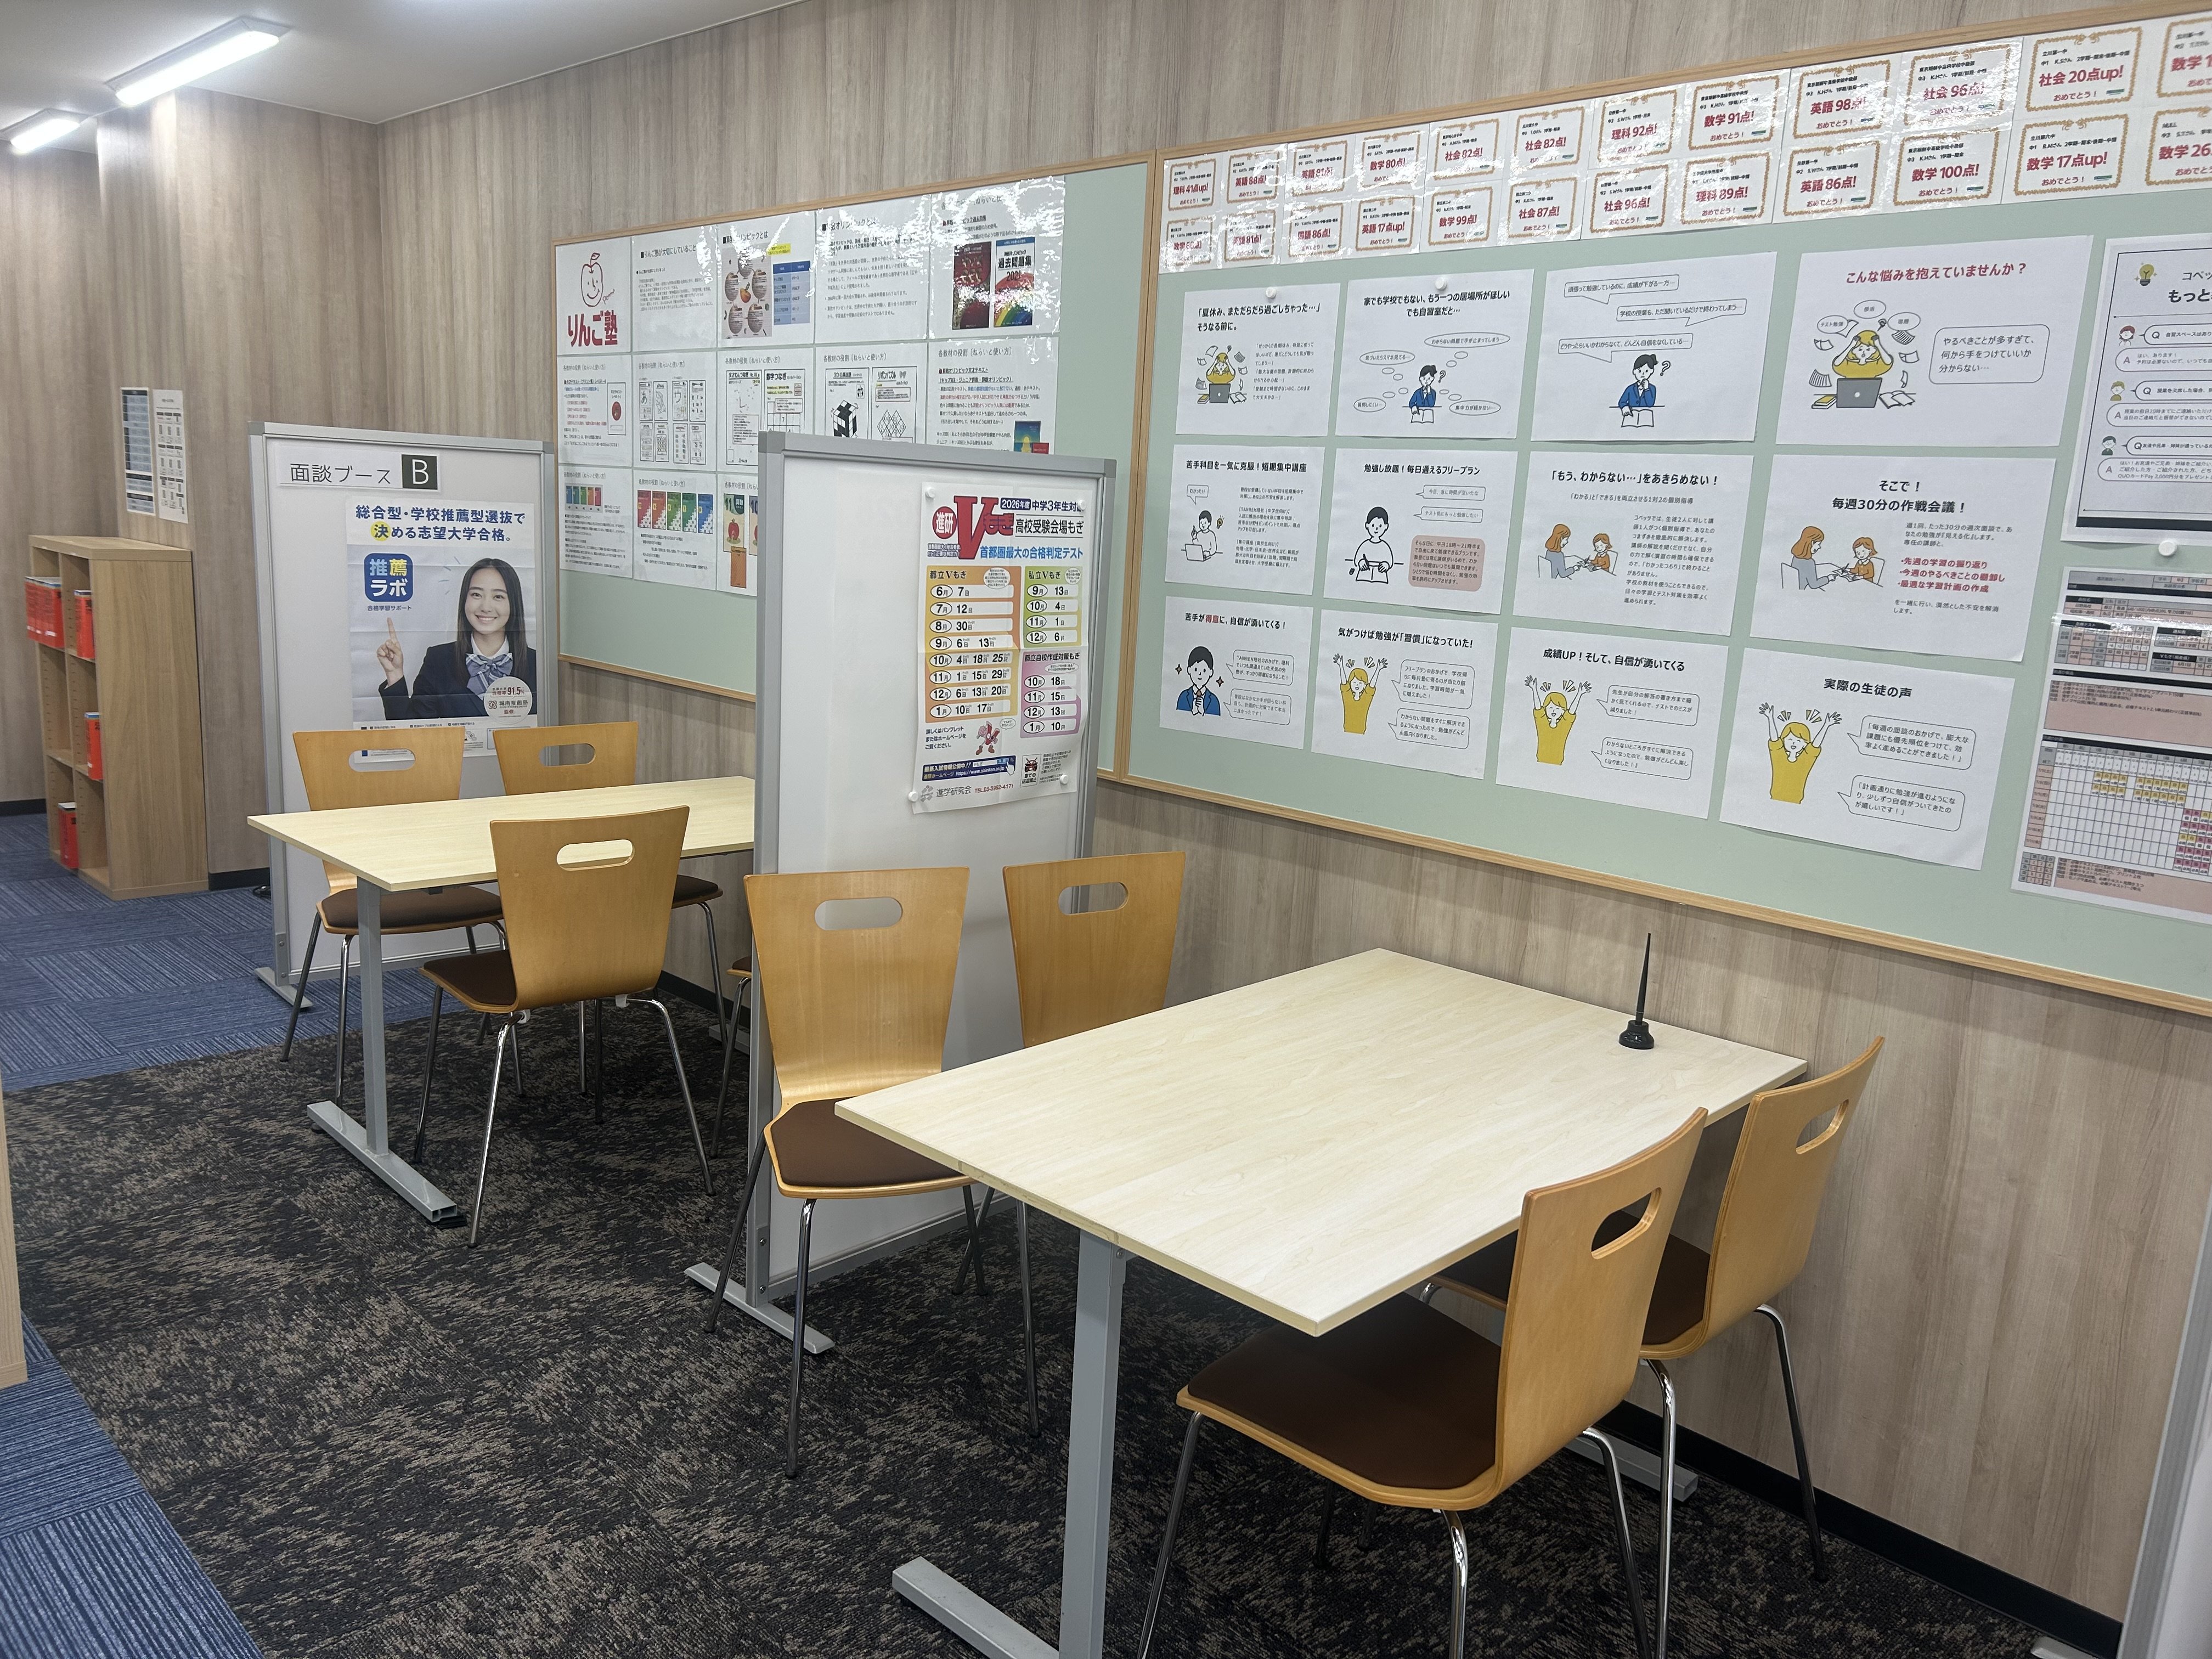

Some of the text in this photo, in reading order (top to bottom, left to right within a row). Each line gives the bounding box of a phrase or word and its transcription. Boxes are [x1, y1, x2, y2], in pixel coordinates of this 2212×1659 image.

[2039, 65, 2123, 87] 社会 20点up!
[1704, 114, 1726, 128] 数学
[1525, 137, 1566, 151] 社会 82点!
[2027, 152, 2107, 172] 数学 17点up!
[1912, 164, 1979, 182] 数学 100点!
[1801, 177, 1856, 193] 英語 86点!
[1519, 206, 1559, 219] 社会 87点!
[1604, 201, 1623, 212] 社会
[1439, 215, 1477, 228] 数学 99点!
[1362, 222, 1404, 234] 英語 17点up!
[1846, 262, 2027, 284] こんな悩みを抱えていませんか？
[2168, 289, 2212, 302] もっと
[568, 310, 618, 347] りんご塾
[1198, 322, 1237, 332] そうなる前に。
[1943, 335, 2034, 346] やるべきことが多すぎて、
[1941, 349, 2032, 359] 何から手をつけていいか
[290, 459, 430, 485] 面談ブース B
[1186, 460, 1307, 472] 苦手科目を一気に克服！短期集中講座
[1364, 464, 1480, 476] 勉強し放題！毎日通えるフリープラン
[1879, 480, 1921, 492] そこで！
[1002, 499, 1030, 509] 2026年度
[1832, 497, 1966, 514] 毎週30分の作戦会議！
[356, 505, 526, 524] 総合型・学校推薦型選抜で
[1015, 518, 1084, 534] 高校受験会場もぎ
[374, 524, 510, 542] 決める志望大学合格。
[980, 546, 1084, 559] 首都圏最大の合格判定テスト
[370, 558, 408, 577] 推薦
[930, 571, 966, 579] 都立Vもぎ
[1029, 571, 1060, 579] 私立Vもぎ
[370, 579, 408, 597] ラボ
[936, 586, 969, 596] 6月 7日
[1032, 586, 1068, 595] 9月 13日
[936, 605, 973, 613] 7月 12日
[1030, 601, 1065, 611] 10月 4日
[935, 622, 972, 630] 8月 30日
[1030, 617, 1065, 626] 11月 1日
[1185, 613, 1285, 629] 苦手が得意に、自信が湧いてくる！
[935, 638, 995, 648] 9月 6日 13日
[1030, 633, 1065, 641] 12月 6日
[934, 653, 1008, 665] 10月 4日 18日 25日
[1543, 648, 1685, 672] 成績UP！そして、自信が湧いてくる
[934, 670, 1007, 682] 11月 1日 15日 29日
[1028, 677, 1064, 687] 10月 18日
[934, 686, 1006, 699] 12月 6日 13日 20日
[1824, 678, 1912, 698] 実際の生徒の声
[1028, 692, 1064, 702] 11月 15日
[936, 704, 991, 715] 1月 10日 17日
[1028, 707, 1064, 716] 12月 13日
[1030, 722, 1065, 731] 1月 10日
[936, 786, 971, 797] 進学研究会
